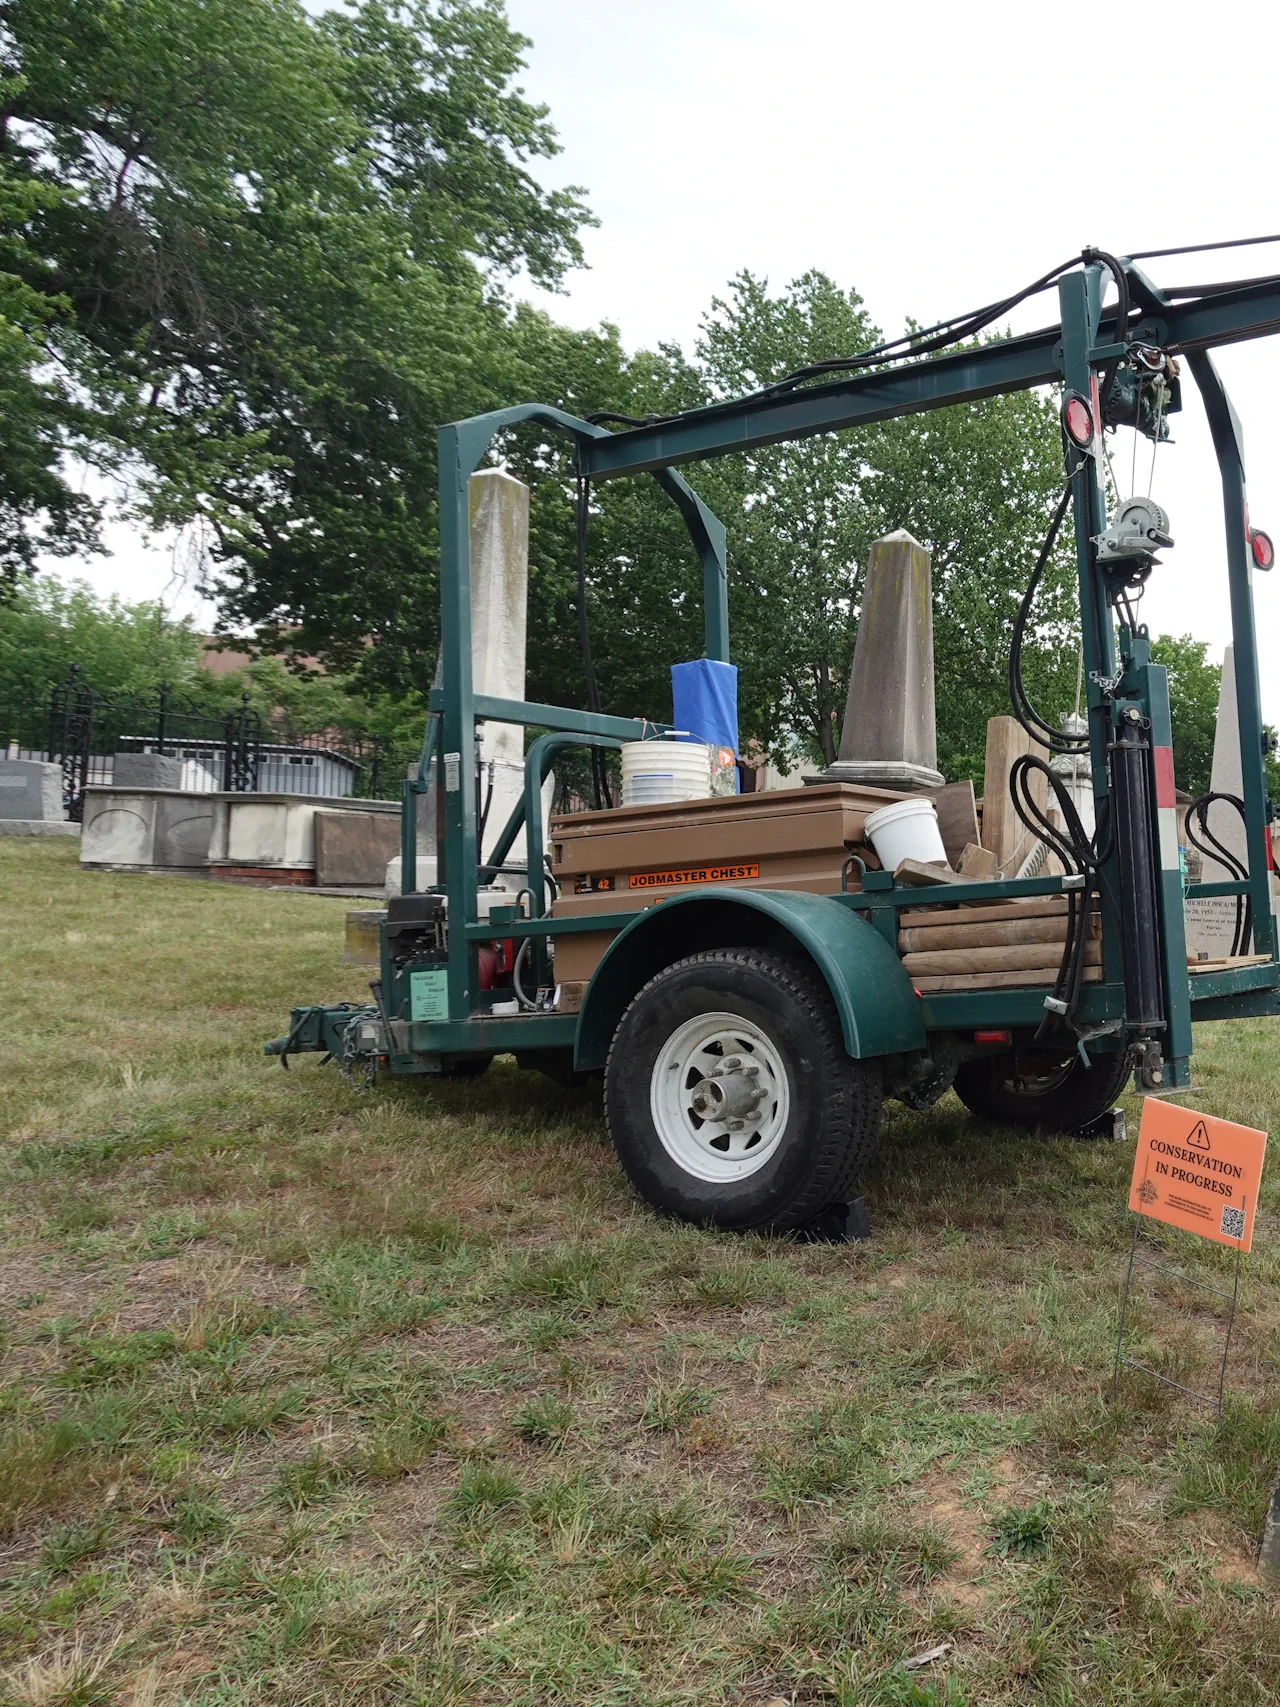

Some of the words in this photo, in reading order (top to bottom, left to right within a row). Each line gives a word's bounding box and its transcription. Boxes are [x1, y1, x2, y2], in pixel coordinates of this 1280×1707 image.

[598, 879, 609, 889] 42
[631, 871, 707, 887] JOBMASTER
[1150, 1139, 1242, 1179] CONSERVATION
[1155, 1161, 1169, 1175] IN
[1171, 1166, 1233, 1198] PROGRESS
